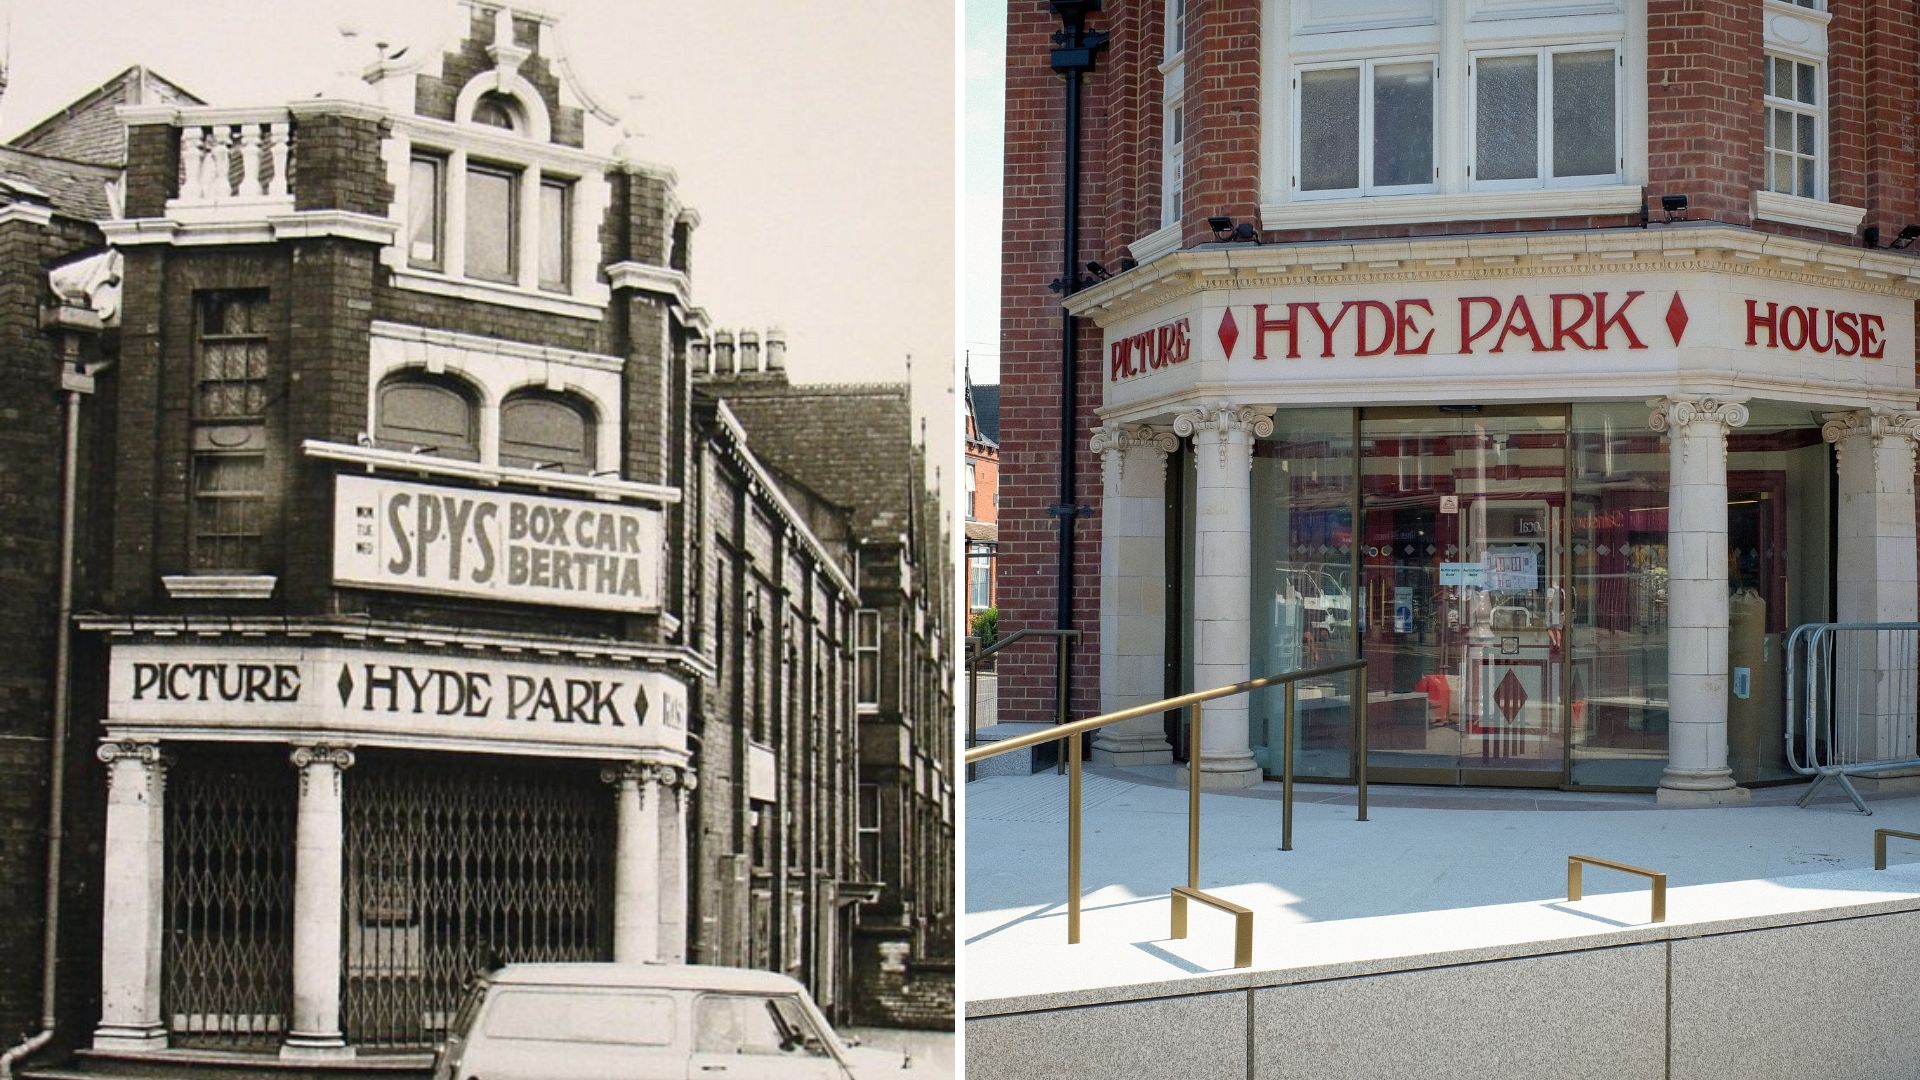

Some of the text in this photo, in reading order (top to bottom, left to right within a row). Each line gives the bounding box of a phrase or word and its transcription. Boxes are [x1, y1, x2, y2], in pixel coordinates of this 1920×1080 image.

[1111, 317, 1190, 382] PICTURE
[1252, 290, 1648, 361] HYDE PARK
[1744, 298, 1886, 360] HOUSE
[508, 501, 641, 555] BOX CAR
[507, 544, 643, 598] BERTHA
[132, 662, 302, 702] PICTURE
[362, 663, 495, 718] HYDE
[506, 674, 626, 727] PARK
